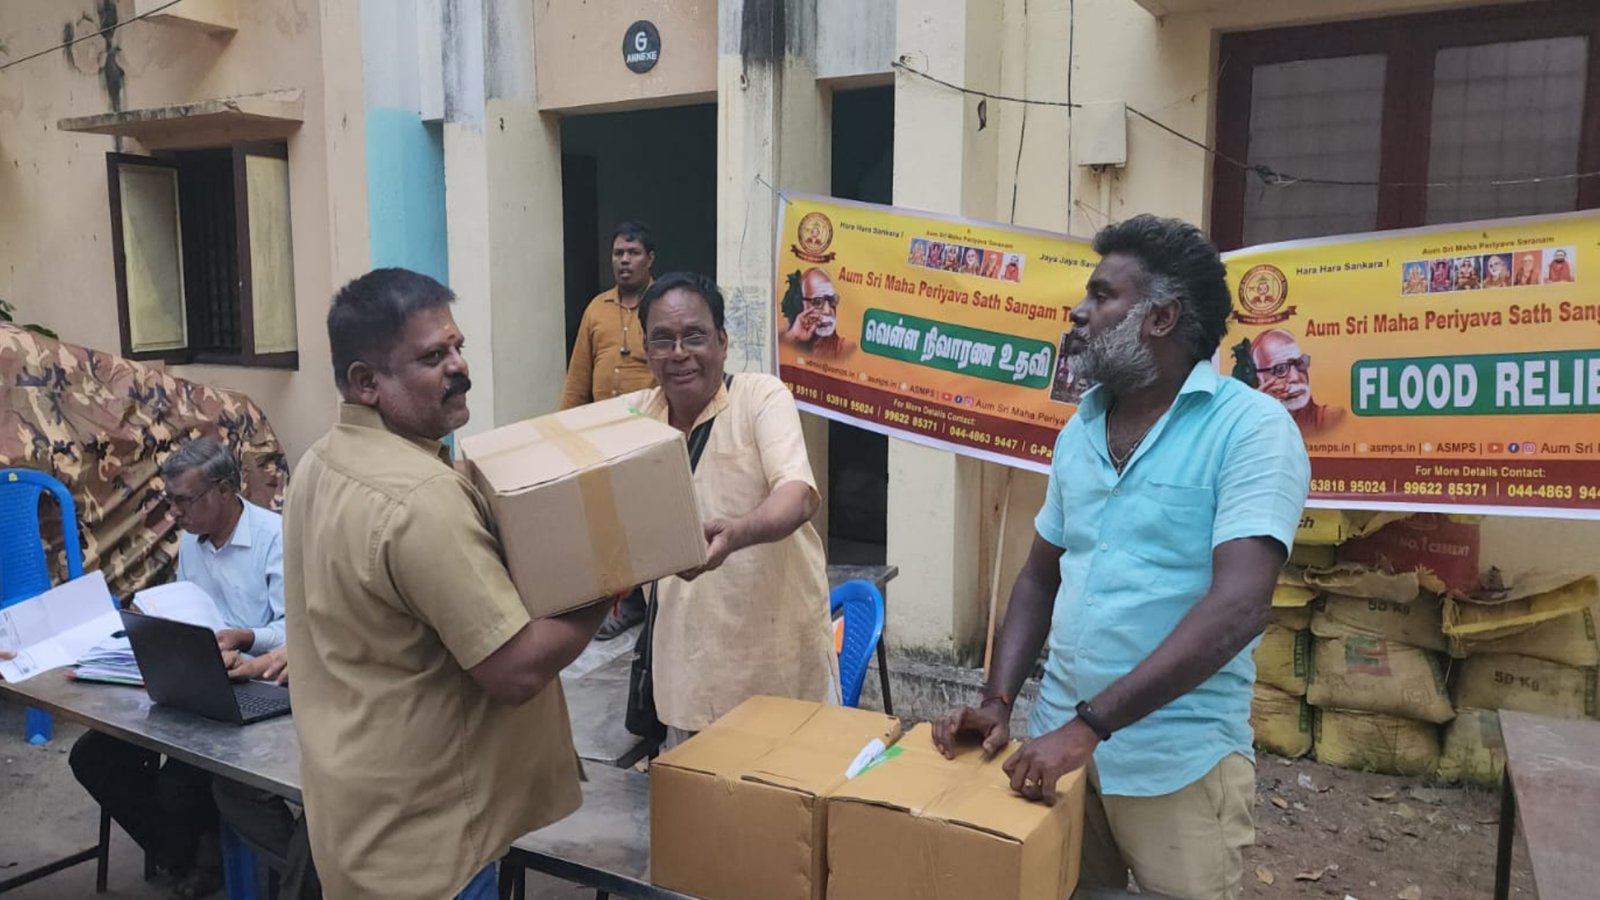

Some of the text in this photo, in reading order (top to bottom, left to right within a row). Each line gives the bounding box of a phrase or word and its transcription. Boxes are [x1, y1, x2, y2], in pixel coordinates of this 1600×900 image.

[626, 51, 658, 63] ANNEXE
[1442, 245, 1454, 254] Sri
[1455, 243, 1478, 253] Maha
[1295, 266, 1317, 277] Hara
[1319, 264, 1342, 275] Hara
[1344, 260, 1385, 272] Sankara
[838, 266, 1072, 323] Aum Sri Maha Periyava Sath Sangam T
[1305, 319, 1340, 338] Aum
[1345, 315, 1368, 336] Sri
[1373, 313, 1419, 334] Maha
[1425, 309, 1502, 334] Periyava
[1508, 302, 1552, 325] Sath
[865, 317, 1051, 381] வெள்ள நிவாரண உதவி
[1359, 363, 1478, 410] FLOOD
[893, 398, 977, 427] For More Details Contact:
[910, 384, 935, 397] ASMPS
[975, 400, 995, 414] Aum
[997, 403, 1009, 416] Sri
[1011, 405, 1035, 420] Maha
[1037, 411, 1067, 427] Periya
[826, 393, 849, 409] 63818
[850, 399, 875, 416] 95024
[884, 408, 910, 425] 99622
[912, 416, 937, 432] 85371
[950, 426, 991, 445] 044-4863
[995, 433, 1018, 450] 9447
[1030, 443, 1053, 458] G-Pa
[1307, 441, 1350, 454] asmps.in
[1369, 441, 1415, 455] asmps.in
[1436, 442, 1477, 454] ASMPS
[1540, 442, 1570, 454] Aum
[1575, 442, 1593, 454] Sri
[1415, 464, 1547, 478] For More Details Contact:
[1310, 479, 1345, 492] 63818
[1350, 480, 1386, 493] 95024
[1404, 481, 1443, 495] 99622
[1448, 483, 1487, 496] 85371
[1507, 484, 1572, 499] 044-4863
[1494, 670, 1514, 686] 50
